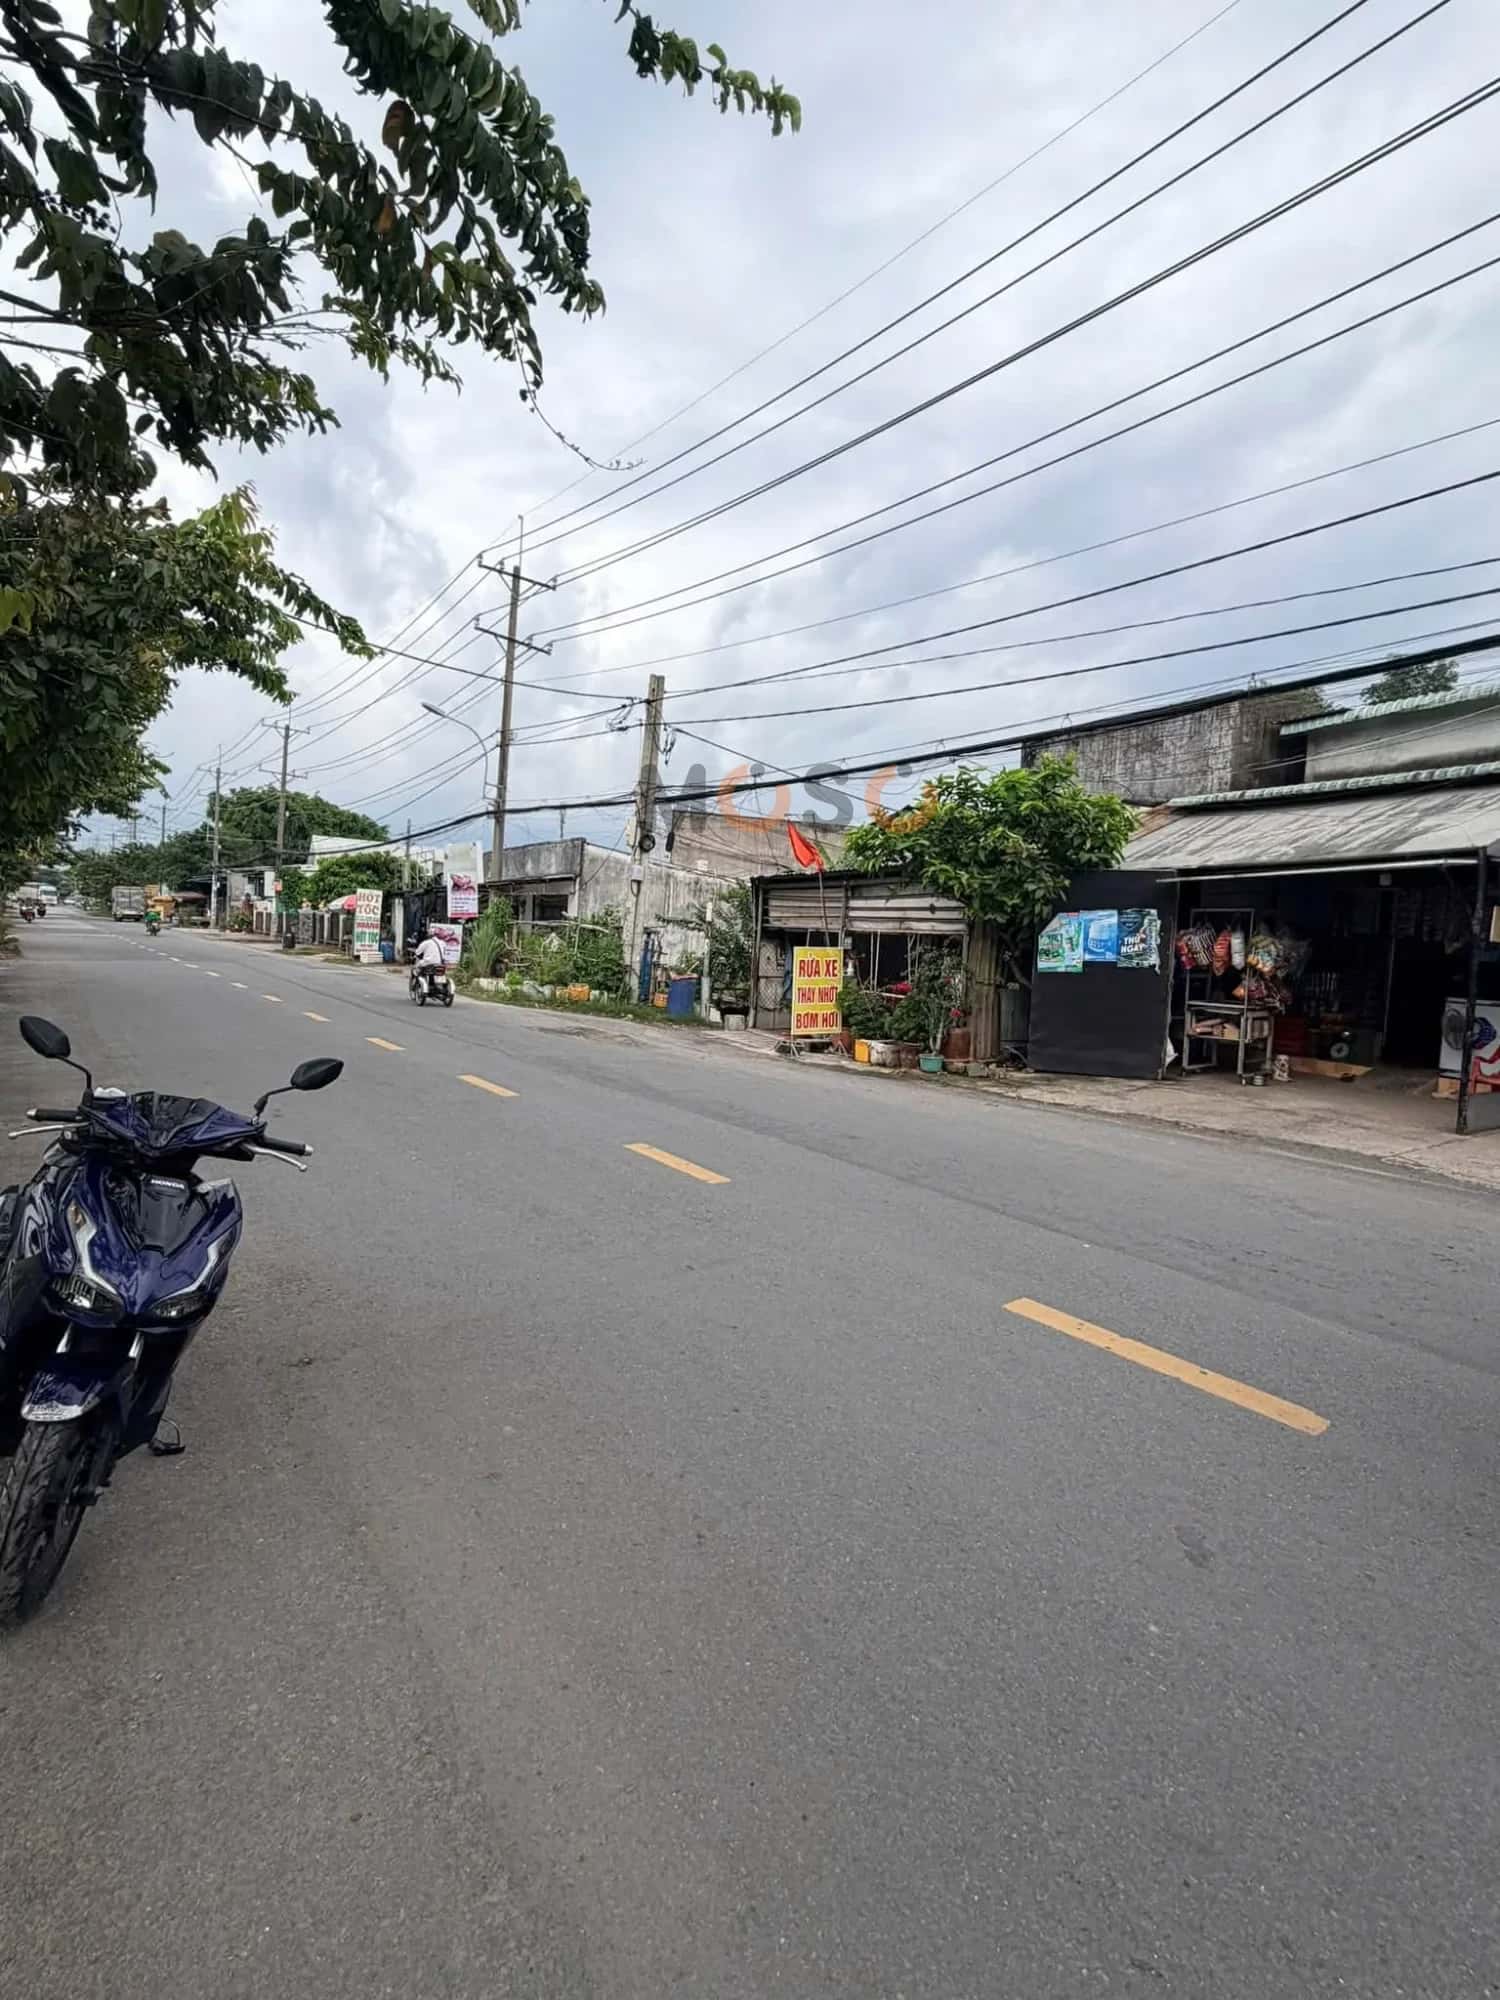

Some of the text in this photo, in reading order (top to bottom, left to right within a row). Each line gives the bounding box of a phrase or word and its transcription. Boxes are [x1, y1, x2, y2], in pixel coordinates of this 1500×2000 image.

[798, 953, 838, 977] RỬA XE
[798, 987, 815, 1003] THAY
[796, 1012, 818, 1029] BƠM
[151, 1179, 185, 1189] HONDA
